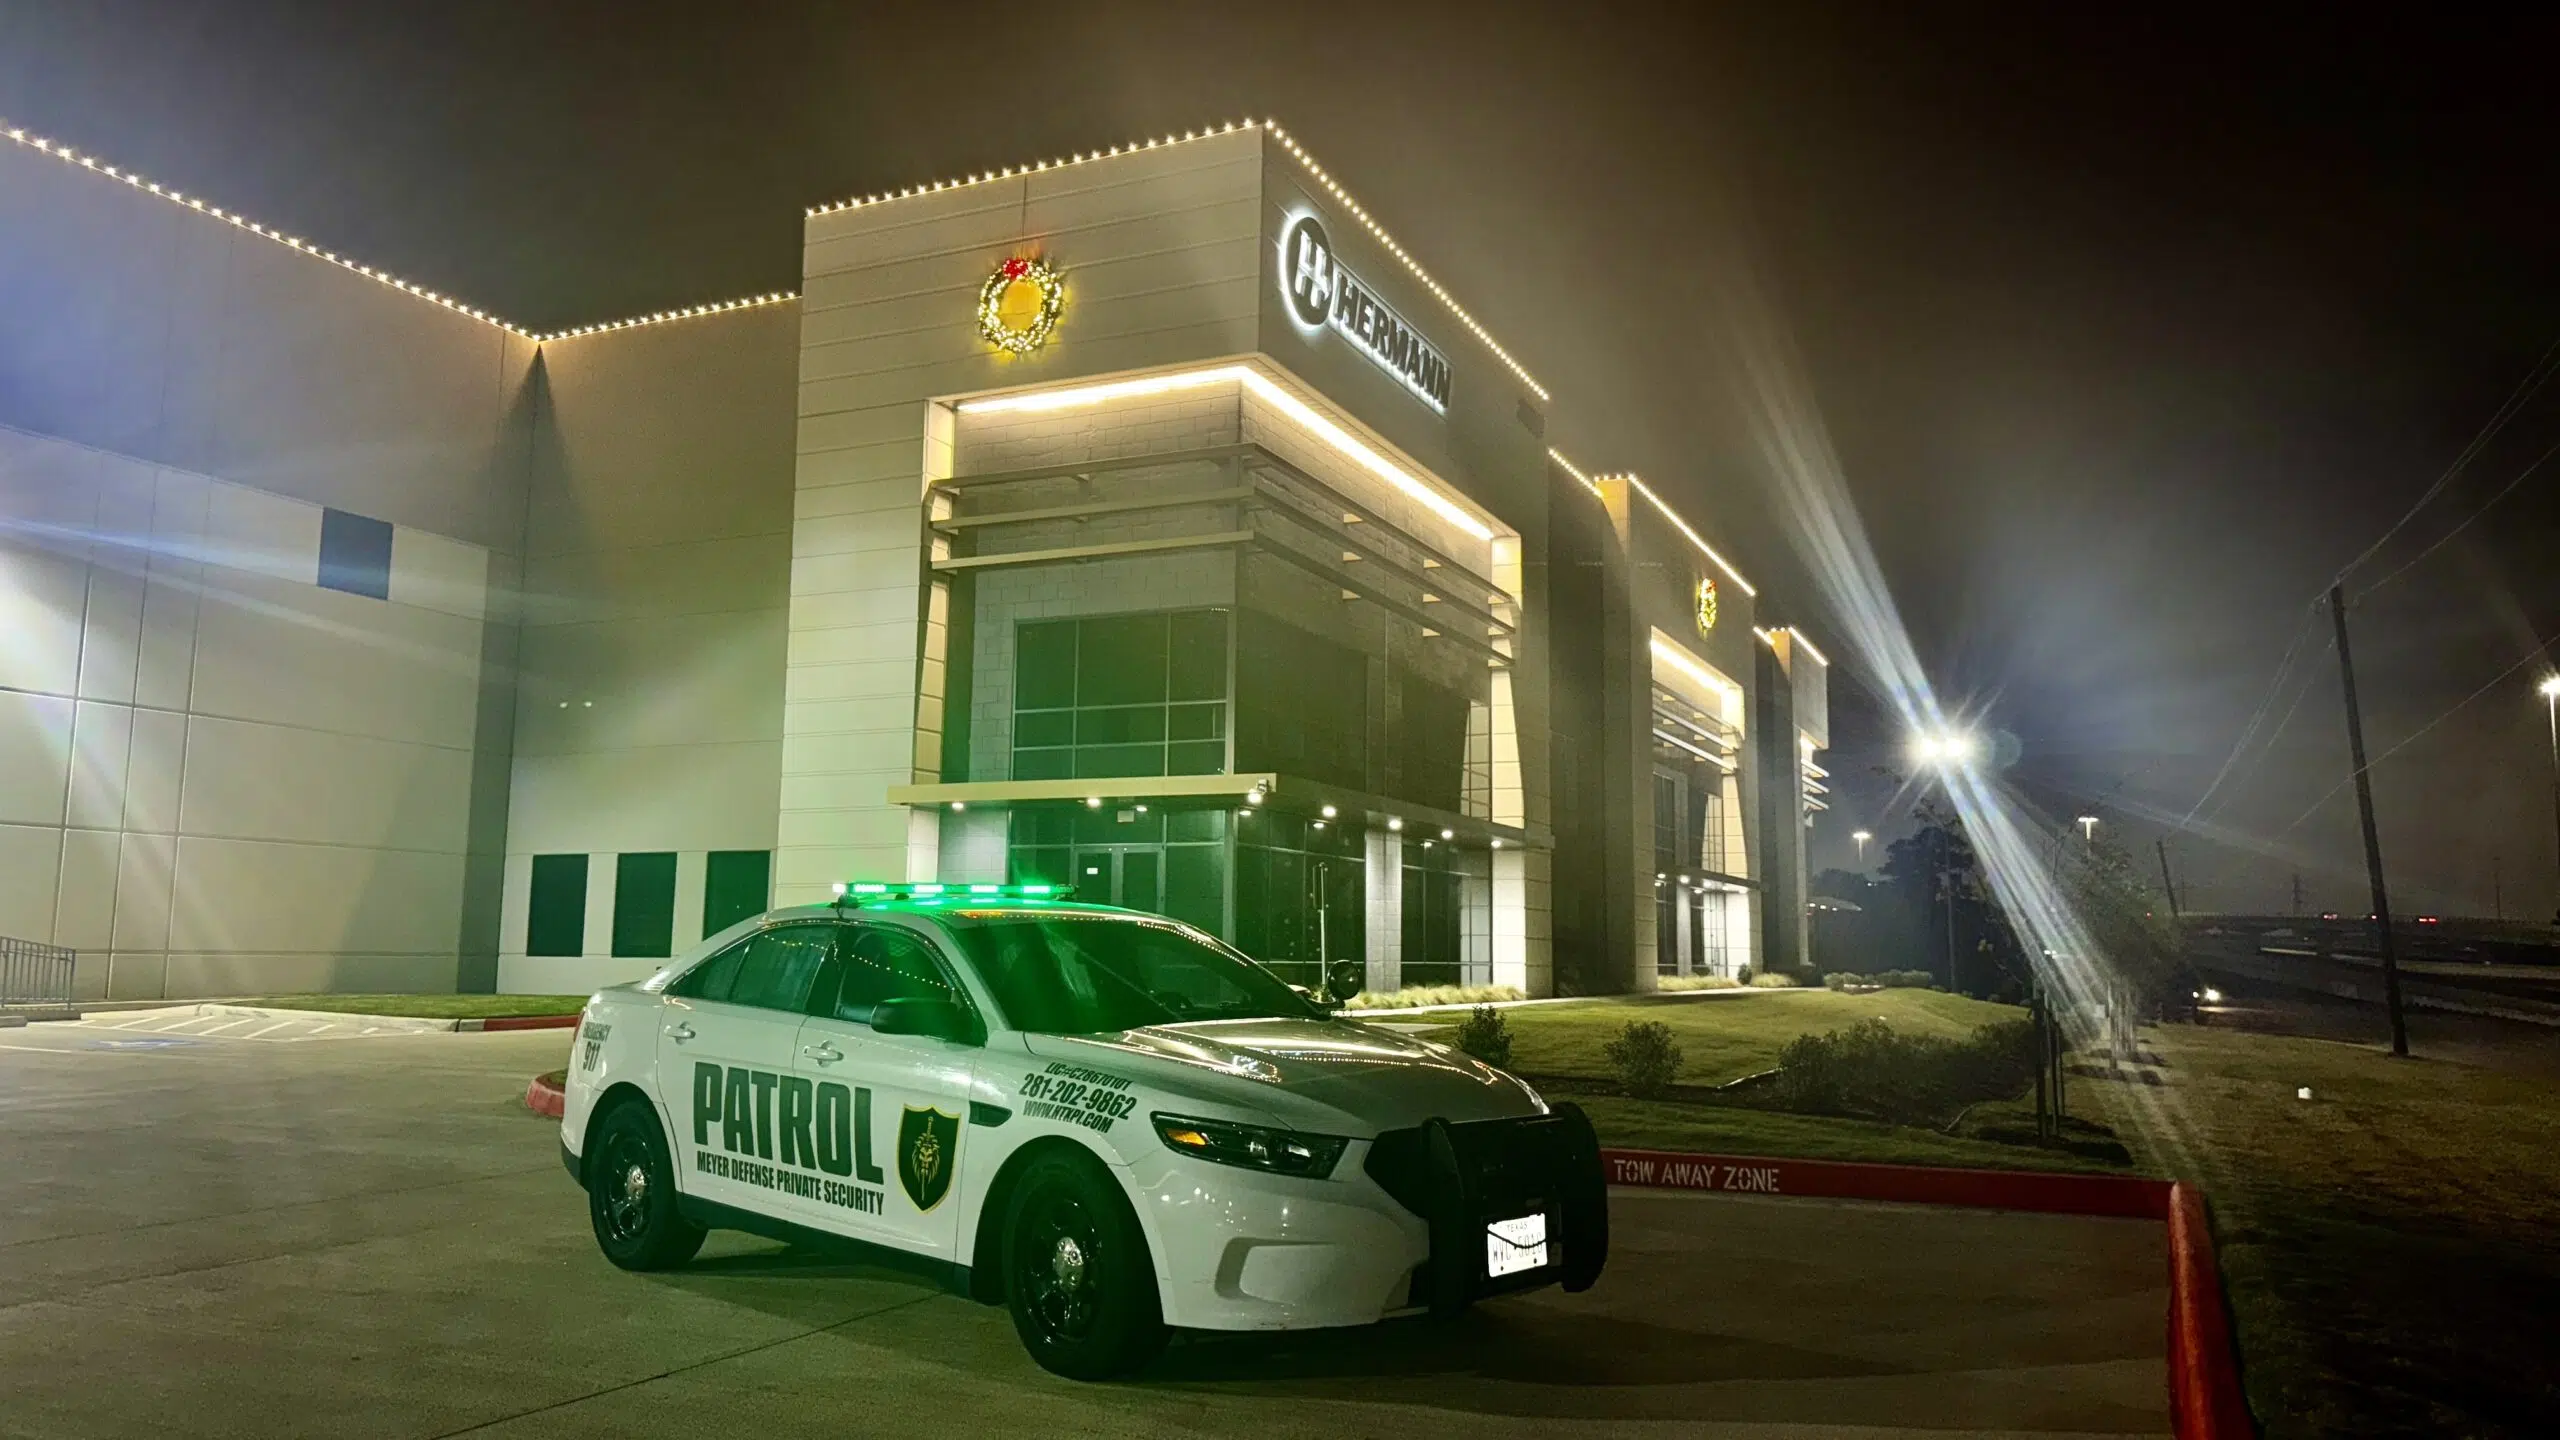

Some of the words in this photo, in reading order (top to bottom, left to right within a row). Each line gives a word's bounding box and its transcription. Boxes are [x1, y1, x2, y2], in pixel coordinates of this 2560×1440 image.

[1333, 271, 1452, 409] HERMANN
[582, 1041, 601, 1072] 911
[1018, 1073, 1138, 1121] 281-202-9862
[694, 1061, 885, 1185] PATROL
[697, 1150, 730, 1178] MEYER
[731, 1158, 775, 1189] DEFENSE
[776, 1169, 822, 1201] PRIVATE
[823, 1180, 885, 1216] SECURITY
[1614, 1159, 1655, 1183] TOW
[1661, 1163, 1716, 1189] AWAY
[1723, 1166, 1780, 1193] ZONE
[1506, 1222, 1528, 1233] TEXAS
